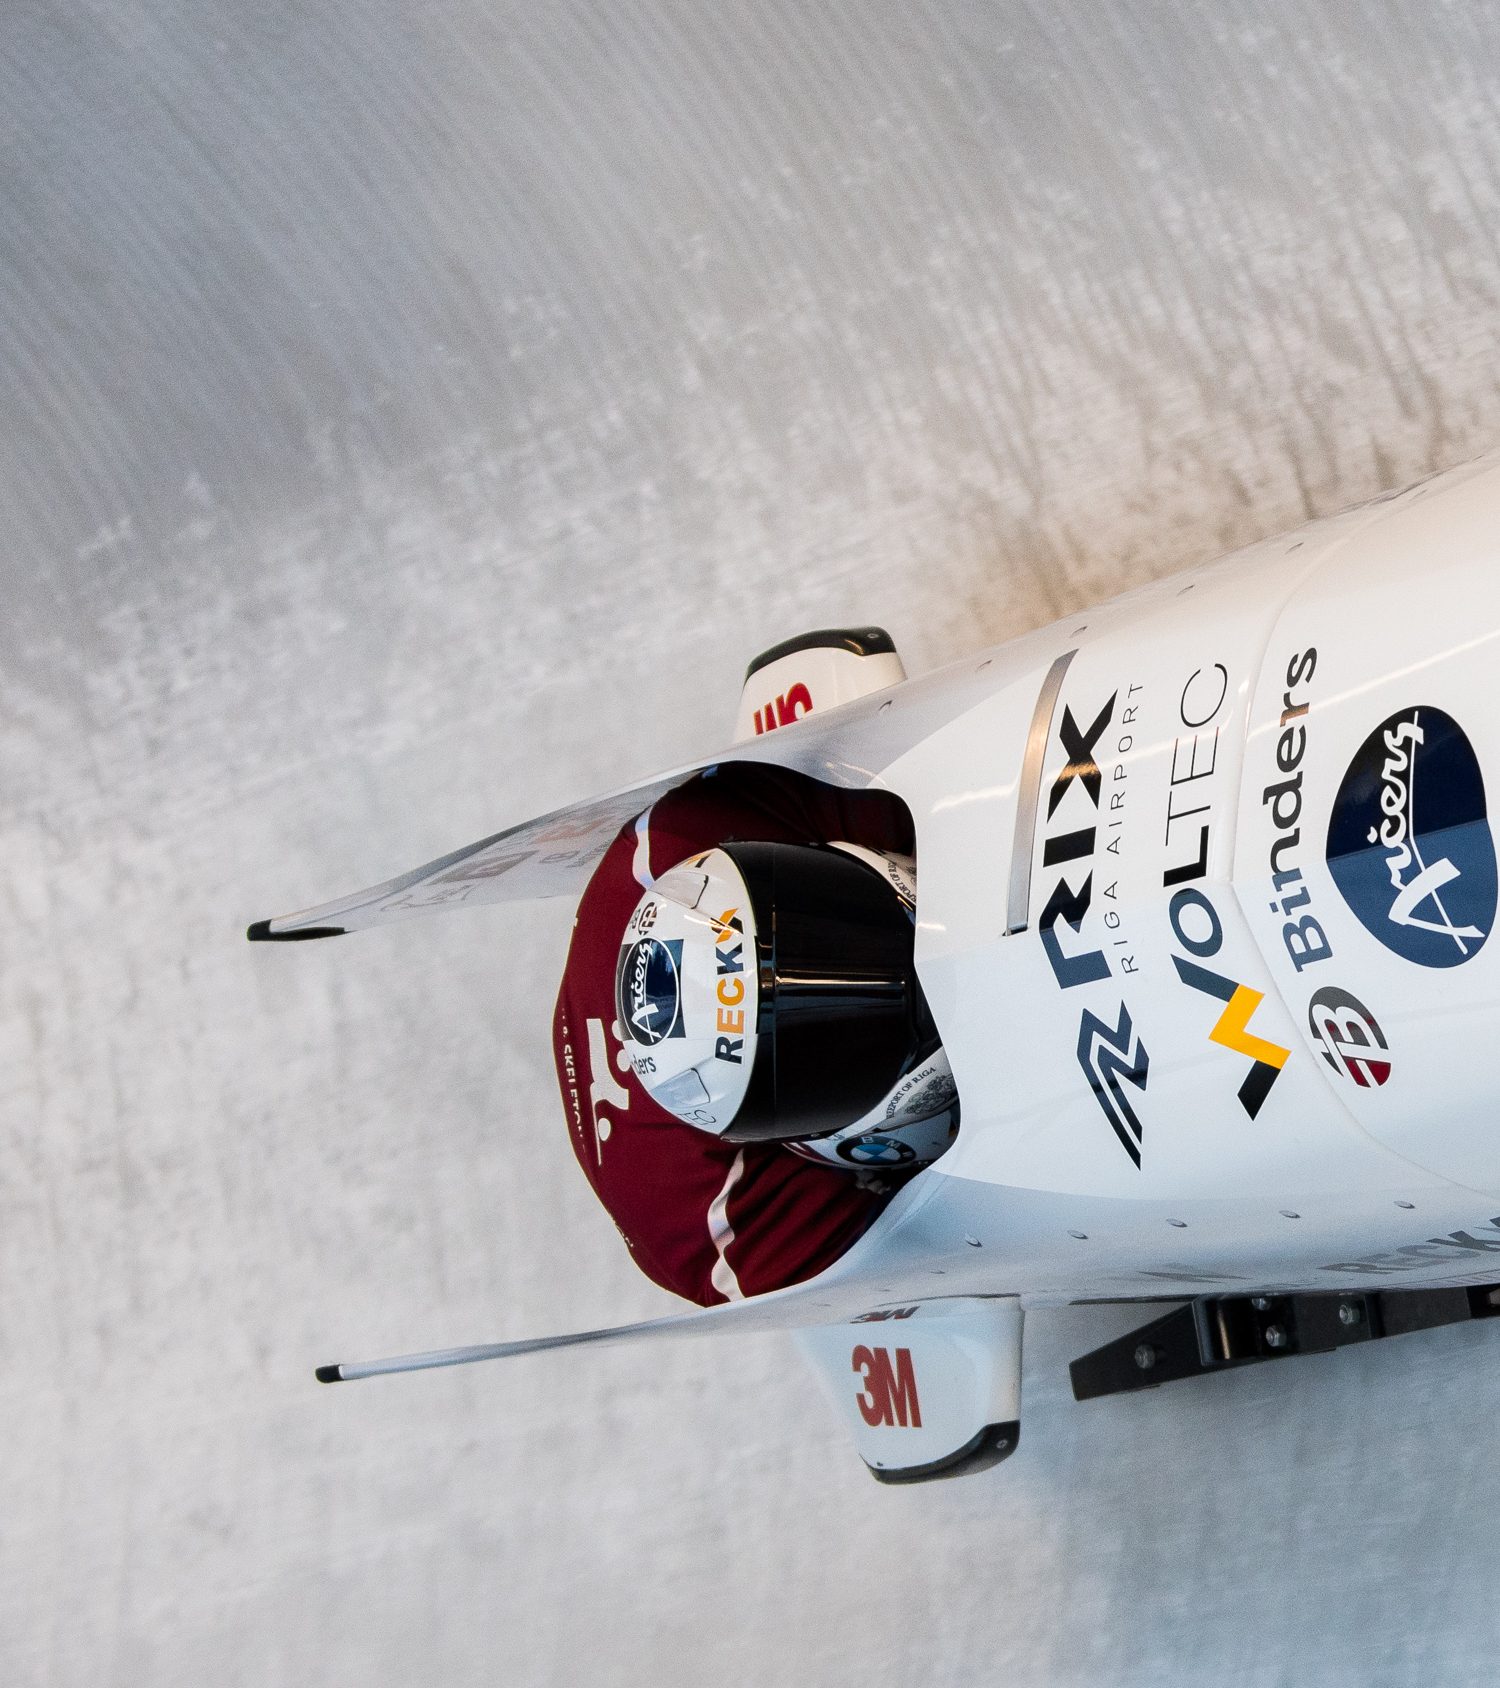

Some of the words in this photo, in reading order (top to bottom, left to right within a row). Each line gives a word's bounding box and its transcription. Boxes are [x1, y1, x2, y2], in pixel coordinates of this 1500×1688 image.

[1038, 688, 1119, 990] RIX
[1106, 683, 1144, 856] AIRPORT
[1262, 647, 1333, 972] Binders
[1103, 881, 1139, 975] RIGA
[851, 1344, 922, 1429] 3M
